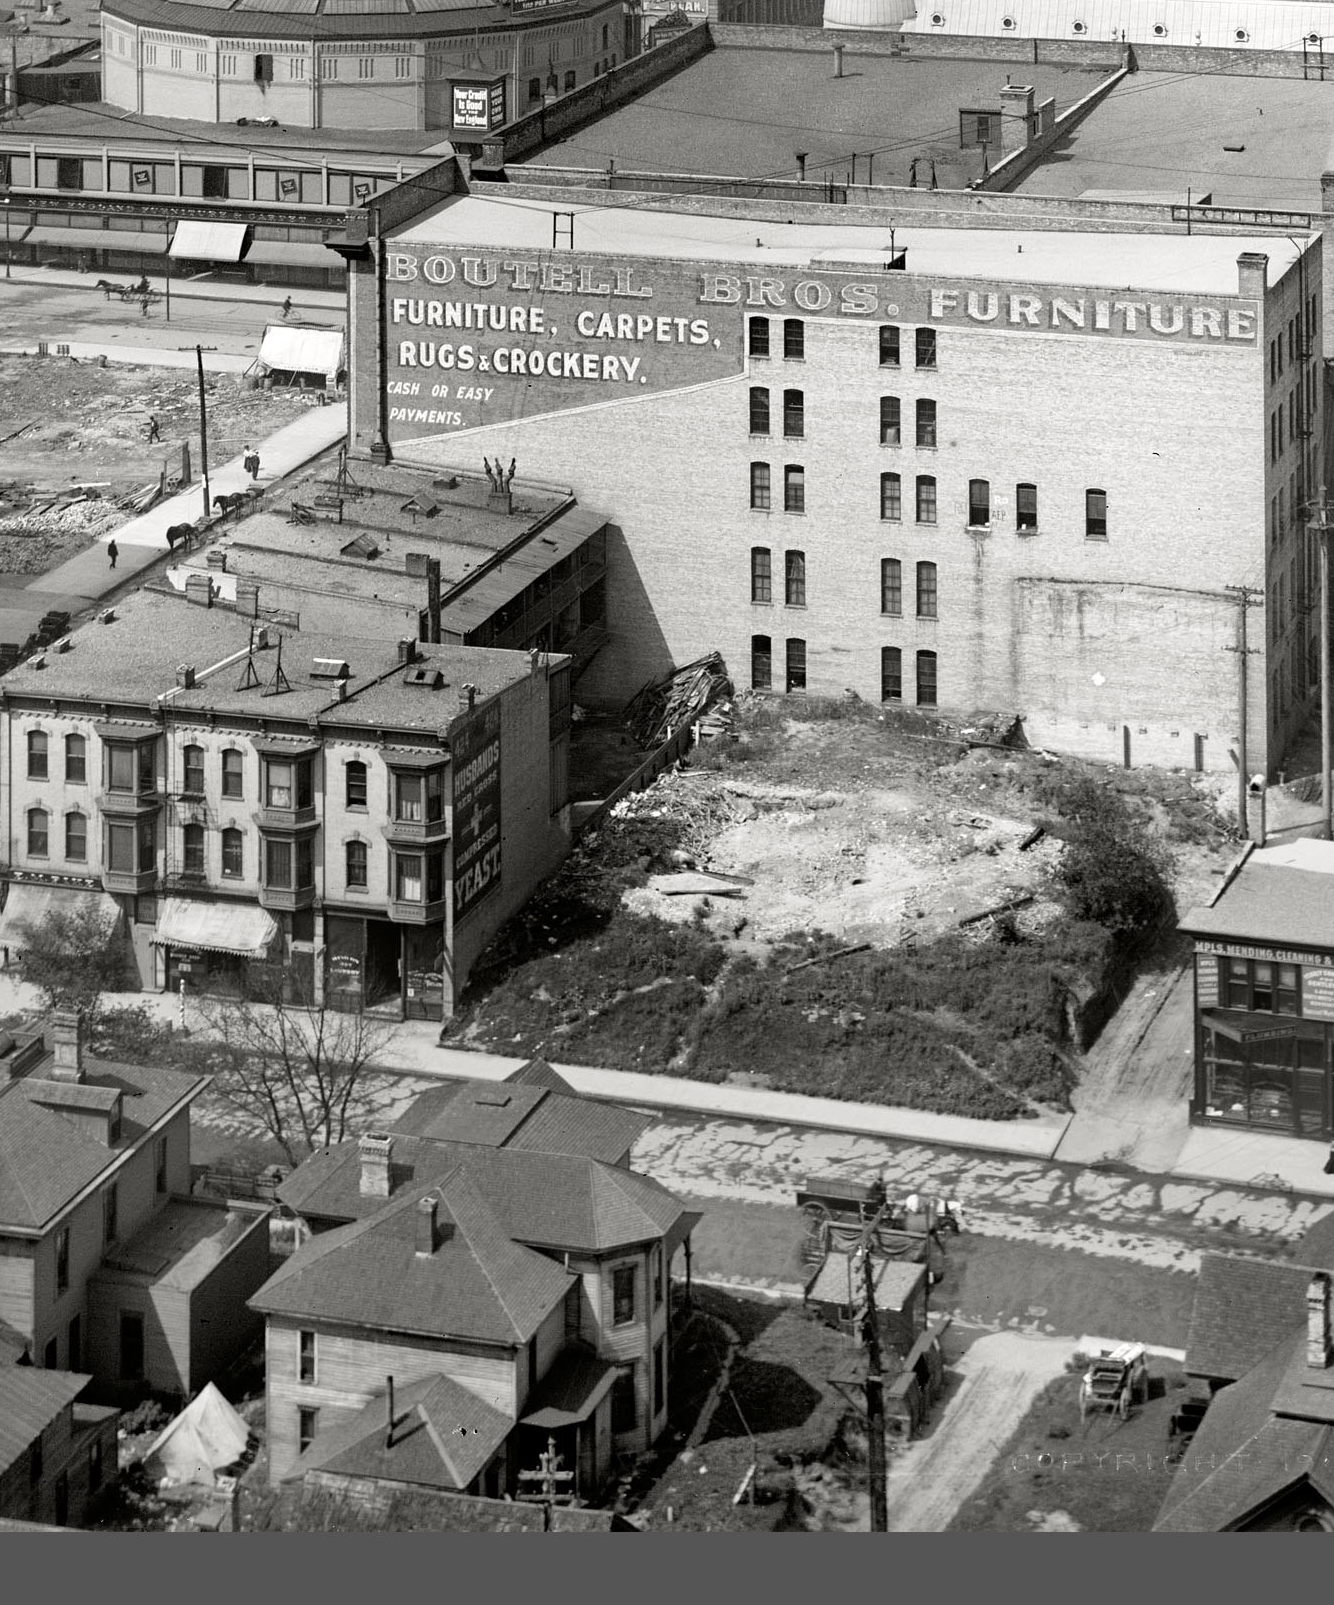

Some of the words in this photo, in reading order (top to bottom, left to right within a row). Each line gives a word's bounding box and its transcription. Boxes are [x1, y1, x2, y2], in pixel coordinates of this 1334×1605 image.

[535, 0, 547, 7] PER
[28, 199, 59, 208] NEW
[67, 201, 135, 213] ENGLAND
[141, 206, 227, 218] FURNITURE
[248, 213, 307, 223] CARPET
[384, 252, 653, 298] BOUTELL
[697, 272, 901, 317] BROS.
[929, 288, 1257, 341] FURNITURE
[392, 298, 558, 338] FURNITURE,
[576, 310, 721, 350] CARPETS,
[492, 347, 647, 384] CROCKERY.
[386, 380, 420, 395] CASH
[431, 383, 449, 396] OR
[456, 385, 495, 402] EASY
[389, 407, 467, 426] PAYMENTS.
[454, 741, 500, 797] HUSBANDS
[1195, 941, 1227, 954] MPLS.
[1276, 951, 1321, 964] CLEANING
